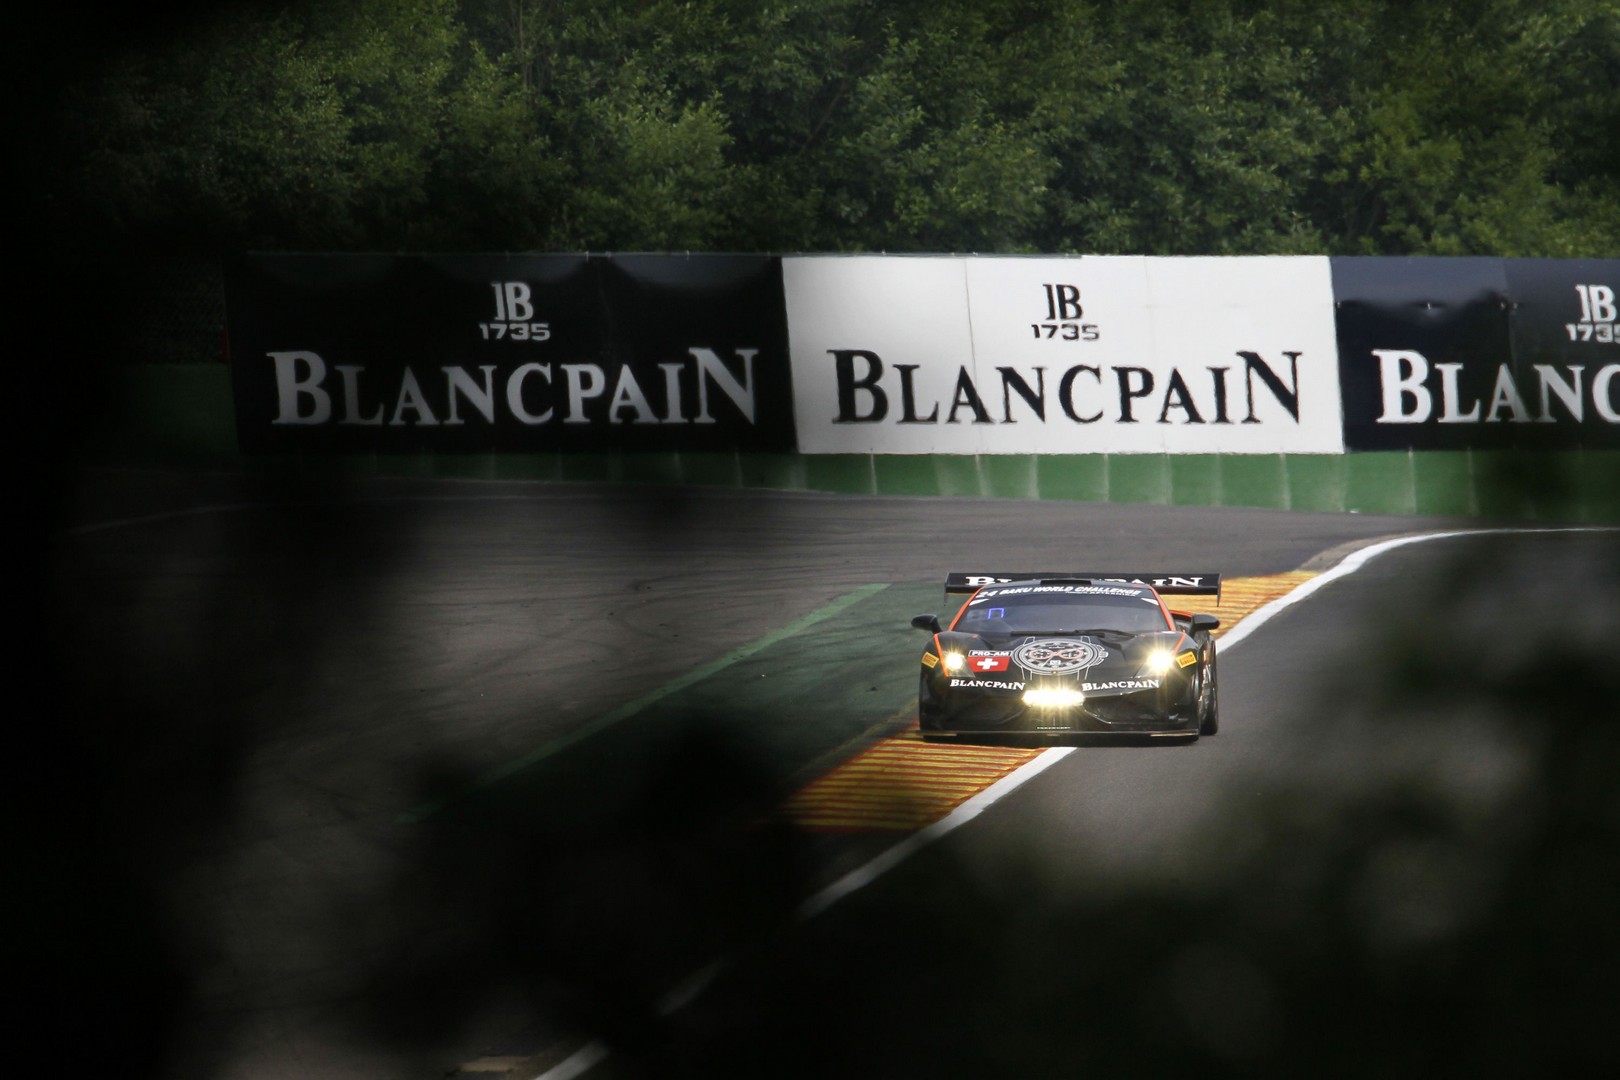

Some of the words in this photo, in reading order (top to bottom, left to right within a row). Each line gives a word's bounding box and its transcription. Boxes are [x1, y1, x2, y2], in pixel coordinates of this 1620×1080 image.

[479, 322, 551, 341] 1735
[1031, 323, 1100, 341] 1735
[266, 347, 759, 426] BLANCPAIN
[826, 349, 1304, 425] BLANCPAIN
[999, 587, 1032, 595] BAKU
[1033, 585, 1074, 593] WORLD
[1074, 586, 1142, 596] CHALLENGE
[950, 679, 1026, 690] BLANCPAIN
[1081, 679, 1160, 691] BLANCPAIN
